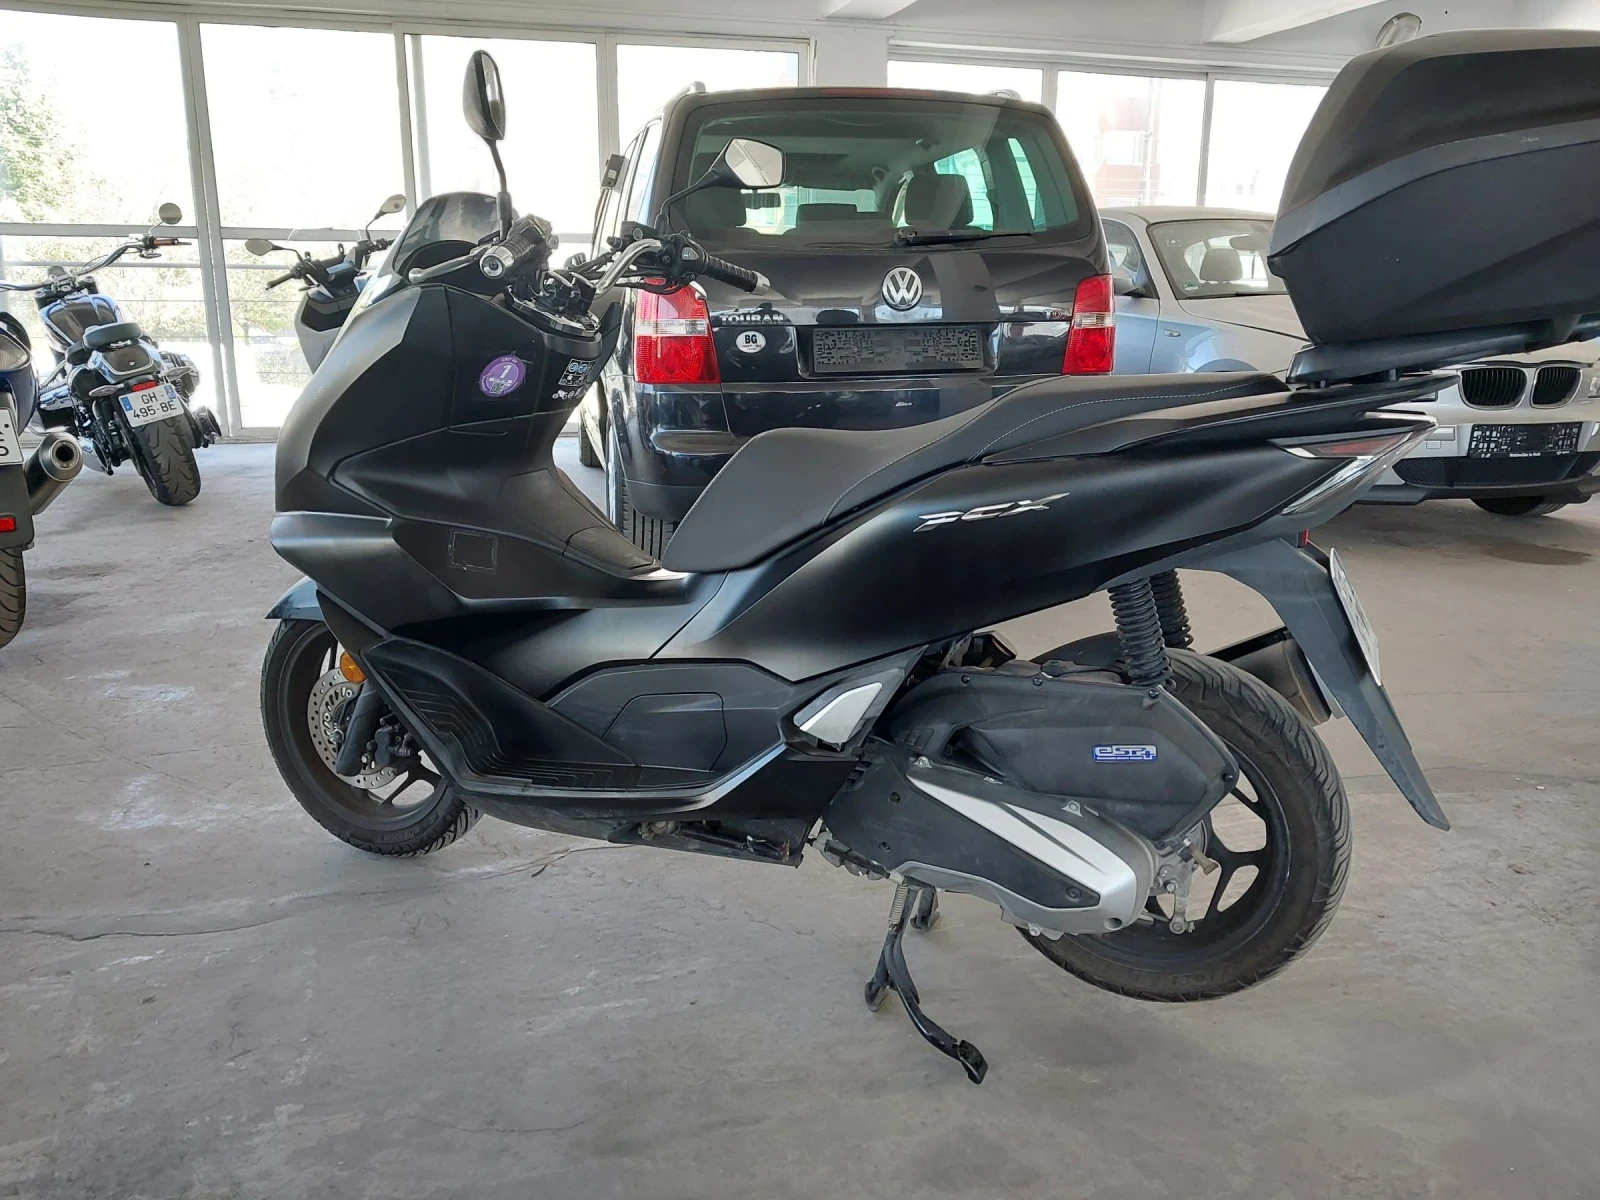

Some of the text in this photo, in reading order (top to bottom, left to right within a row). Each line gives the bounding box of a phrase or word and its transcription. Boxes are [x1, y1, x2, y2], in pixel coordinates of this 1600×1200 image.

[883, 267, 922, 309] VW
[719, 314, 784, 325] TOURAN
[744, 334, 758, 344] BG
[500, 365, 512, 379] 1
[133, 400, 177, 419] 495-BE
[913, 492, 1070, 533] PCX
